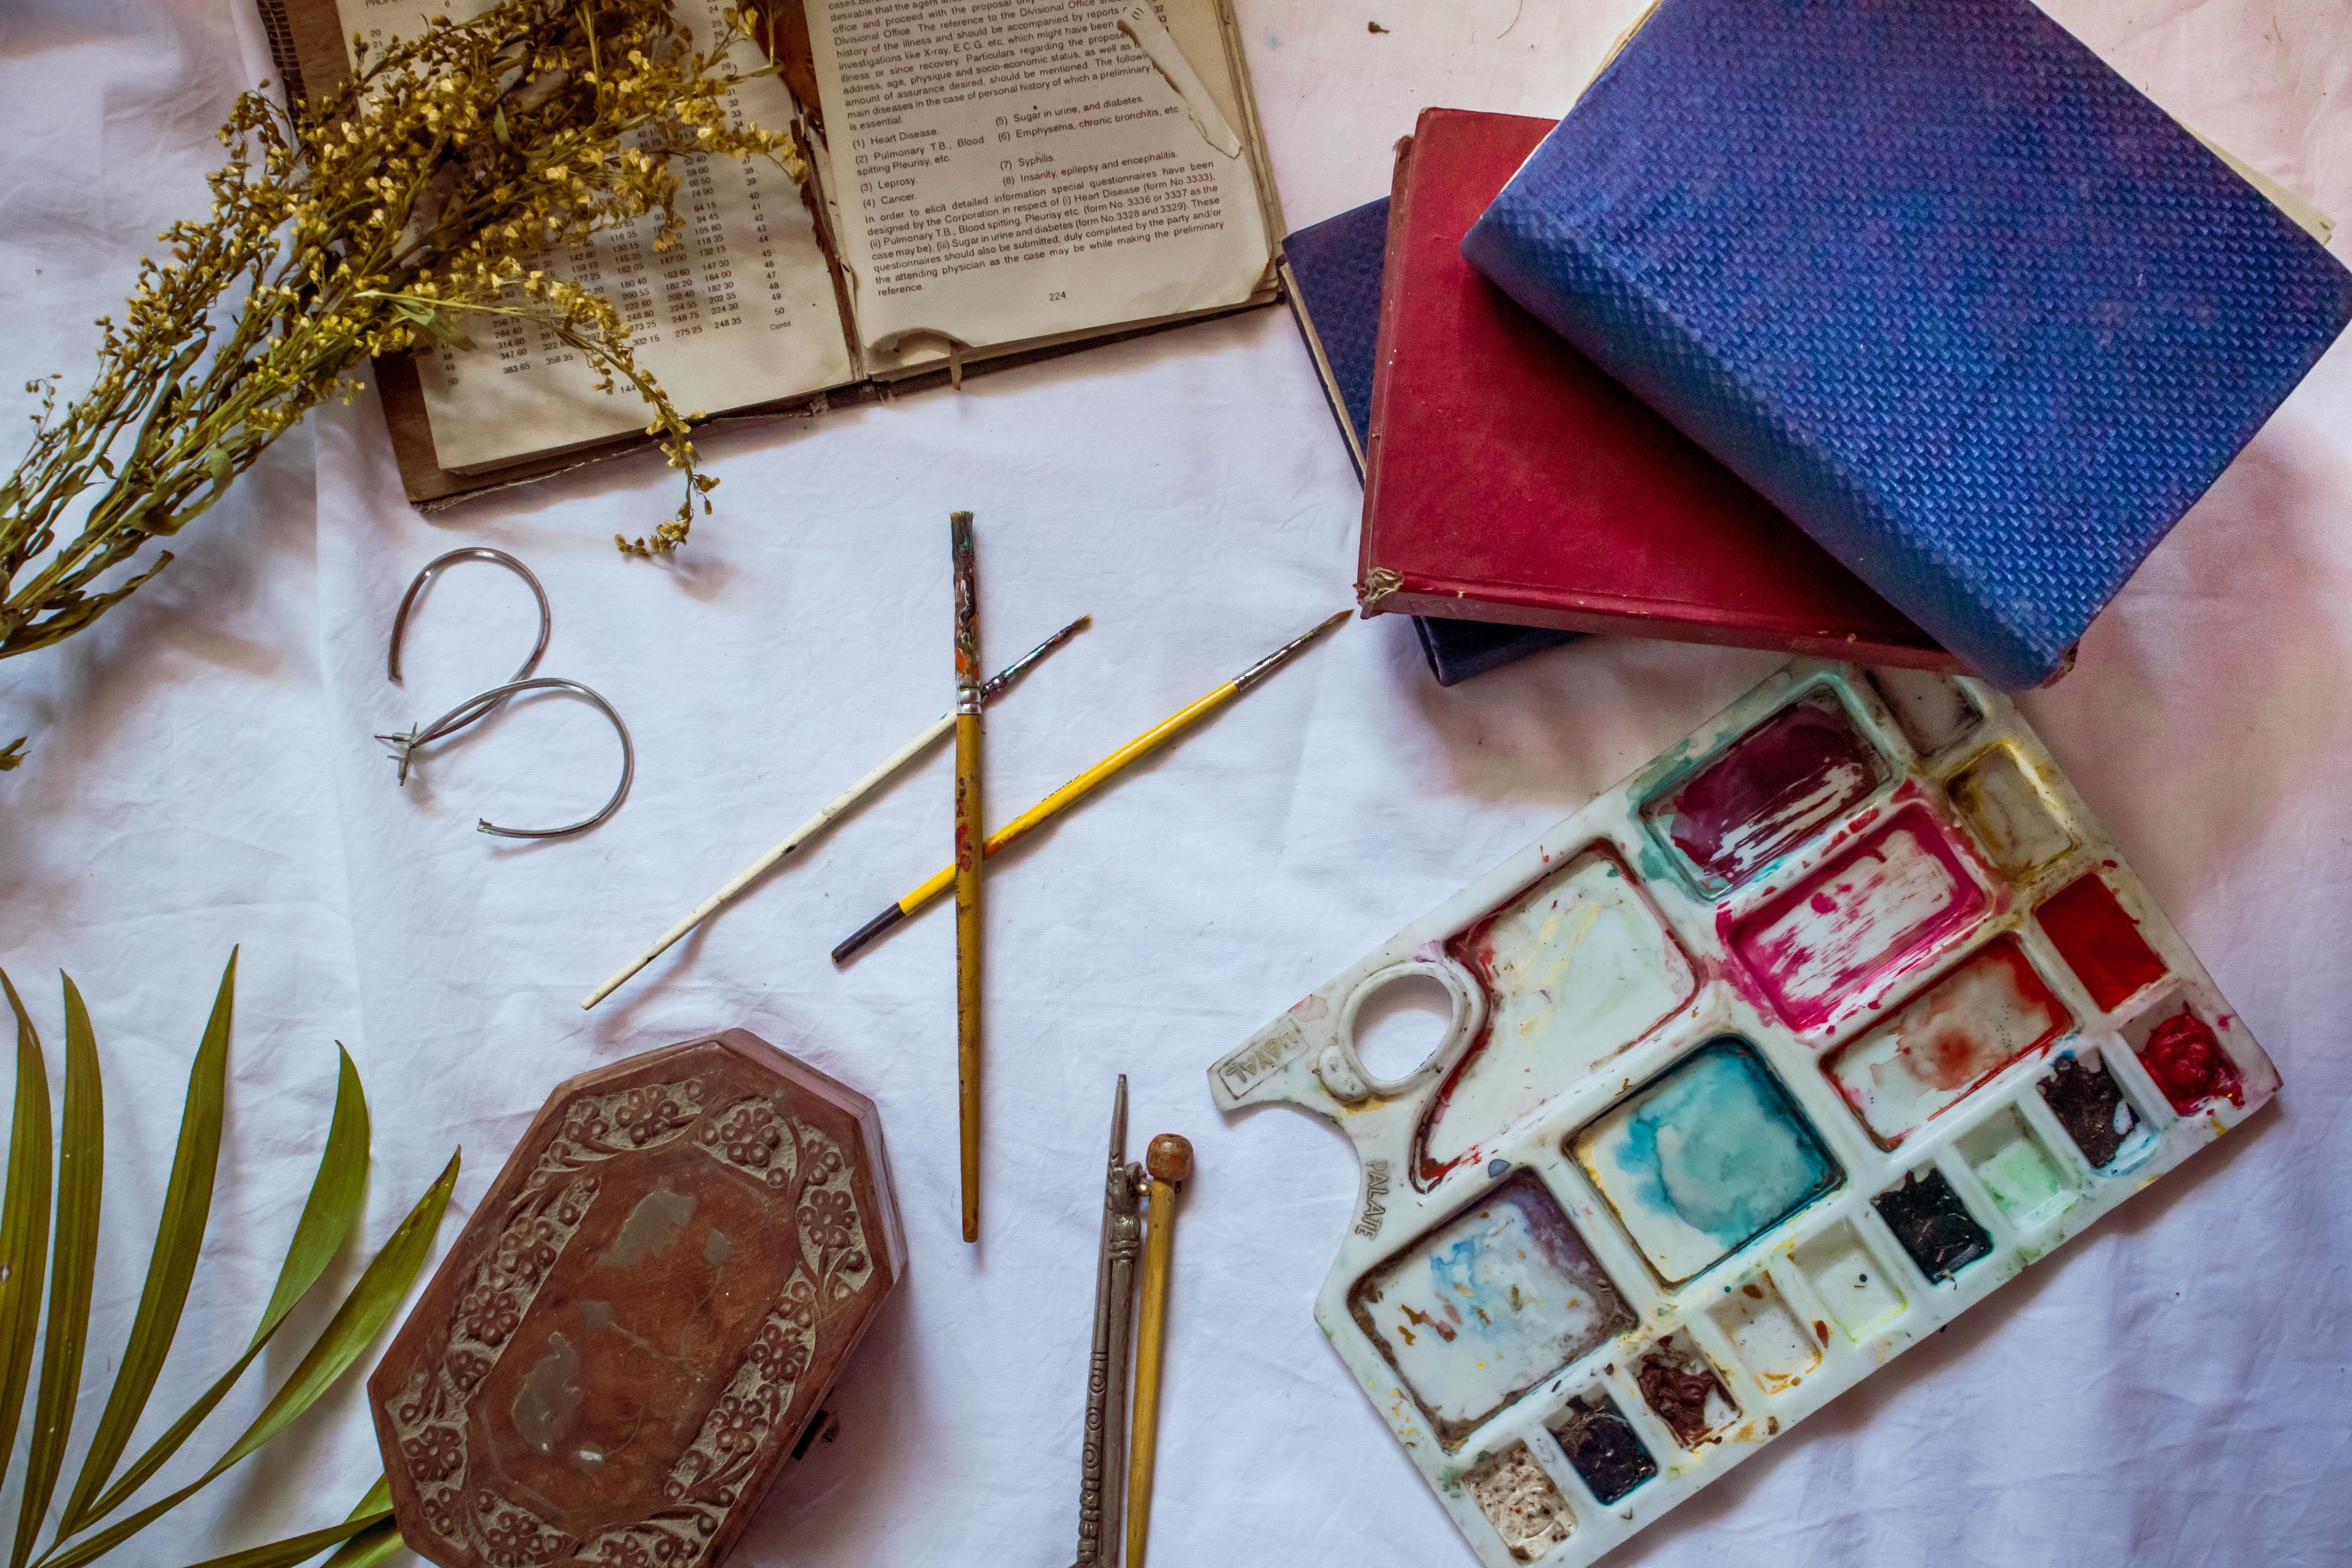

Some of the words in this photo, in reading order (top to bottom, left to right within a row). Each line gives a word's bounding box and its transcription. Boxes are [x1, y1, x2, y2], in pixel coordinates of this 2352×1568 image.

[847, 109, 870, 119] main
[872, 103, 913, 115] diseases
[943, 95, 964, 104] case
[967, 91, 976, 100] of
[978, 85, 1017, 100] personal
[1019, 81, 1050, 91] history
[1052, 78, 1061, 86] of
[1063, 74, 1090, 85] which
[1099, 65, 1152, 80] preliminary
[995, 117, 1008, 127] (5)
[1013, 112, 1041, 123] Sugar
[1055, 107, 1080, 116] urine,
[1083, 102, 1101, 111] and
[998, 132, 1010, 142] (6)
[1079, 116, 1112, 127] chronic
[1114, 109, 1161, 122] bronchitis,
[853, 139, 865, 150] (1)
[870, 134, 896, 145] Heart
[899, 129, 939, 140] Disease.
[855, 154, 868, 165] (2)
[873, 147, 924, 160] Pulmonary
[957, 136, 984, 147] Blood
[856, 165, 891, 176] spitting
[892, 159, 932, 169] Pleurisy,
[1000, 161, 1012, 171] (7)
[1003, 176, 1014, 187] (8)
[1020, 170, 1058, 181] Insanity,
[1061, 165, 1098, 176] epilepsy
[1101, 159, 1118, 169] and
[1121, 151, 1178, 165] encephalitis.
[860, 184, 872, 194] (3)
[880, 211, 904, 221] order
[925, 204, 946, 214] elicit
[951, 197, 989, 209] detailed
[994, 189, 1046, 202] information
[1051, 181, 1084, 194] special
[1089, 171, 1157, 188] questionnaires
[1162, 167, 1185, 175] have
[1189, 161, 1214, 171] been
[862, 199, 875, 209] (4)
[867, 222, 910, 236] designed
[913, 221, 924, 230] by
[944, 209, 999, 223] Corporation
[1013, 200, 1047, 212] respect
[1050, 197, 1059, 206] of
[1062, 196, 1071, 206] (i)
[1074, 192, 1099, 202] Heart
[1102, 186, 1140, 198] Disease
[1144, 182, 1167, 192] (form
[883, 233, 933, 245] Pulmonary
[958, 222, 985, 233] Blood
[987, 218, 1022, 230] spitting,
[1025, 211, 1061, 222] Pleurisy
[1084, 204, 1107, 214] (form
[1127, 195, 1151, 206] 3336
[1164, 189, 1187, 200] 3337
[872, 252, 894, 260] case
[895, 248, 914, 257] may
[916, 244, 934, 253] be),
[952, 237, 978, 247] Sugar
[990, 232, 1014, 241] urine
[1016, 227, 1033, 237] and
[1034, 222, 1073, 233] diabetes
[1075, 218, 1099, 229] (form
[1141, 206, 1158, 216] and
[1191, 197, 1219, 207] These
[873, 256, 941, 273] questionnaires
[944, 249, 974, 261] should
[978, 247, 997, 255] also
[1013, 235, 1061, 249] submitted,
[1063, 232, 1082, 241] duly
[1085, 223, 1133, 238] completed
[1135, 222, 1147, 230] by
[1148, 219, 1164, 227] the
[1167, 214, 1189, 226] party
[1193, 209, 1221, 219] and/or
[895, 269, 938, 281] attending
[942, 261, 985, 275] physician
[1023, 251, 1045, 260] case
[1049, 247, 1069, 256] may
[1089, 239, 1112, 249] while
[1117, 234, 1150, 244] making
[1173, 222, 1224, 237] preliminary
[703, 262, 716, 271] 147
[705, 273, 719, 282] 164
[722, 270, 731, 279] 00
[707, 284, 721, 293] 182
[724, 281, 734, 290] 30
[1049, 291, 1066, 301] 224
[709, 295, 723, 304] 202
[711, 306, 726, 315] 224
[728, 303, 738, 311] 30
[715, 320, 729, 329] 248
[774, 307, 785, 315] 50
[620, 384, 636, 393] 144
[1354, 1160, 1391, 1241] PALATE
